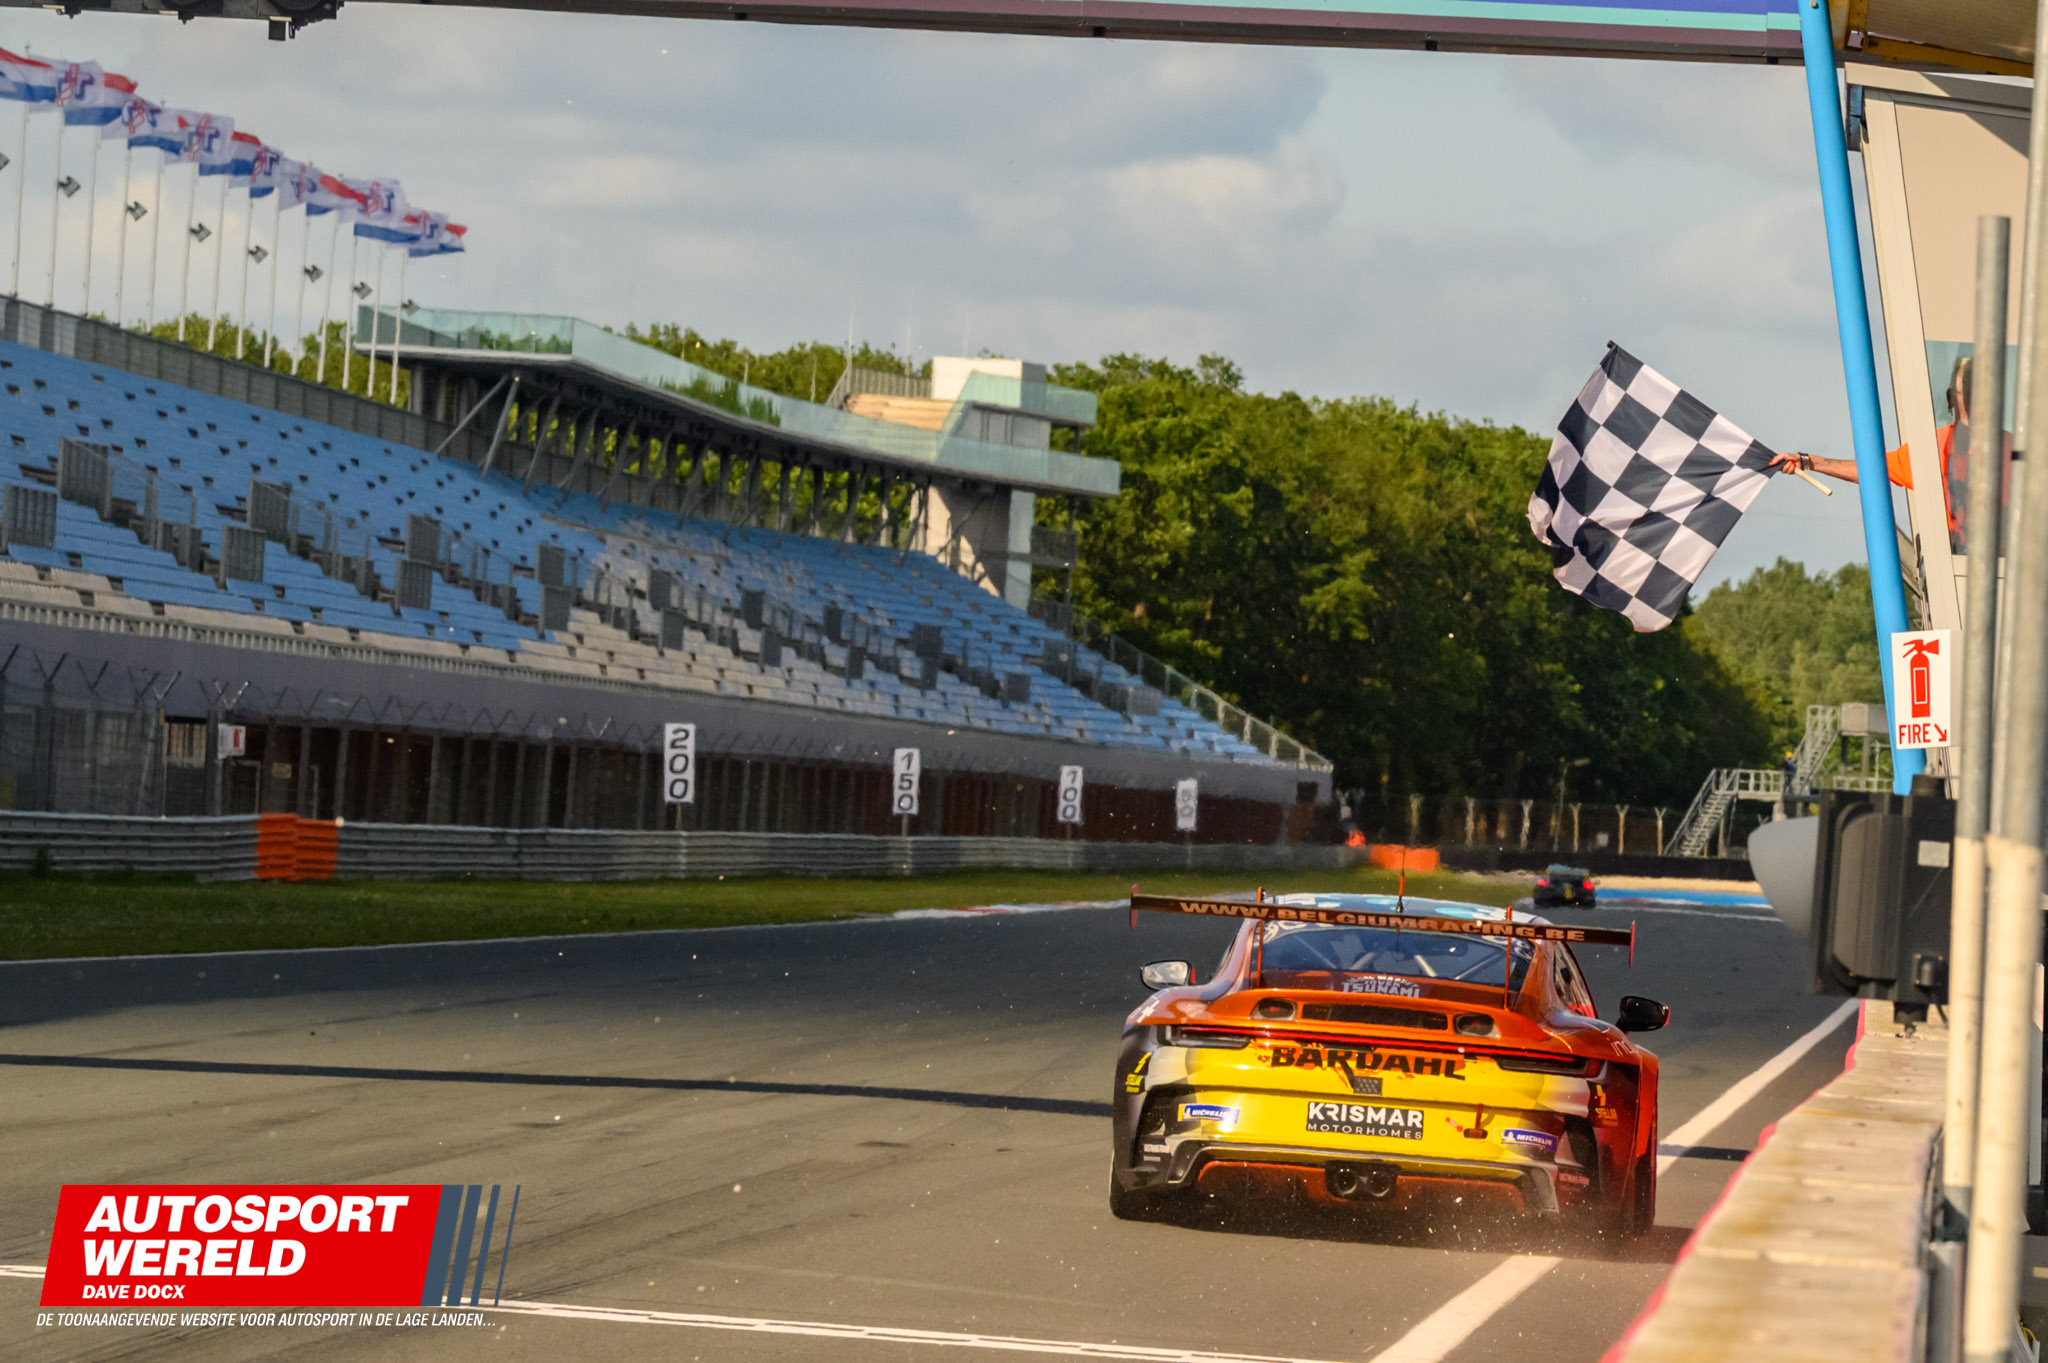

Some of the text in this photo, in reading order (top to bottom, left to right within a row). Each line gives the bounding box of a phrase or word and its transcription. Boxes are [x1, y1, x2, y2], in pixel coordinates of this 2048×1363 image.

[1898, 723, 1931, 745] FIRE
[669, 727, 689, 799] 200
[898, 751, 914, 811] 150
[1062, 770, 1078, 820] 100
[1179, 901, 1585, 942] WWW.BELGIUMRACING.BE
[1341, 982, 1420, 998] TSUNAMI
[1271, 1046, 1466, 1087] BARDAHL
[1307, 1122, 1422, 1140] MOTORHOMES
[1309, 1101, 1423, 1129] KRISMAR
[1516, 1134, 1553, 1146] MICHELIN
